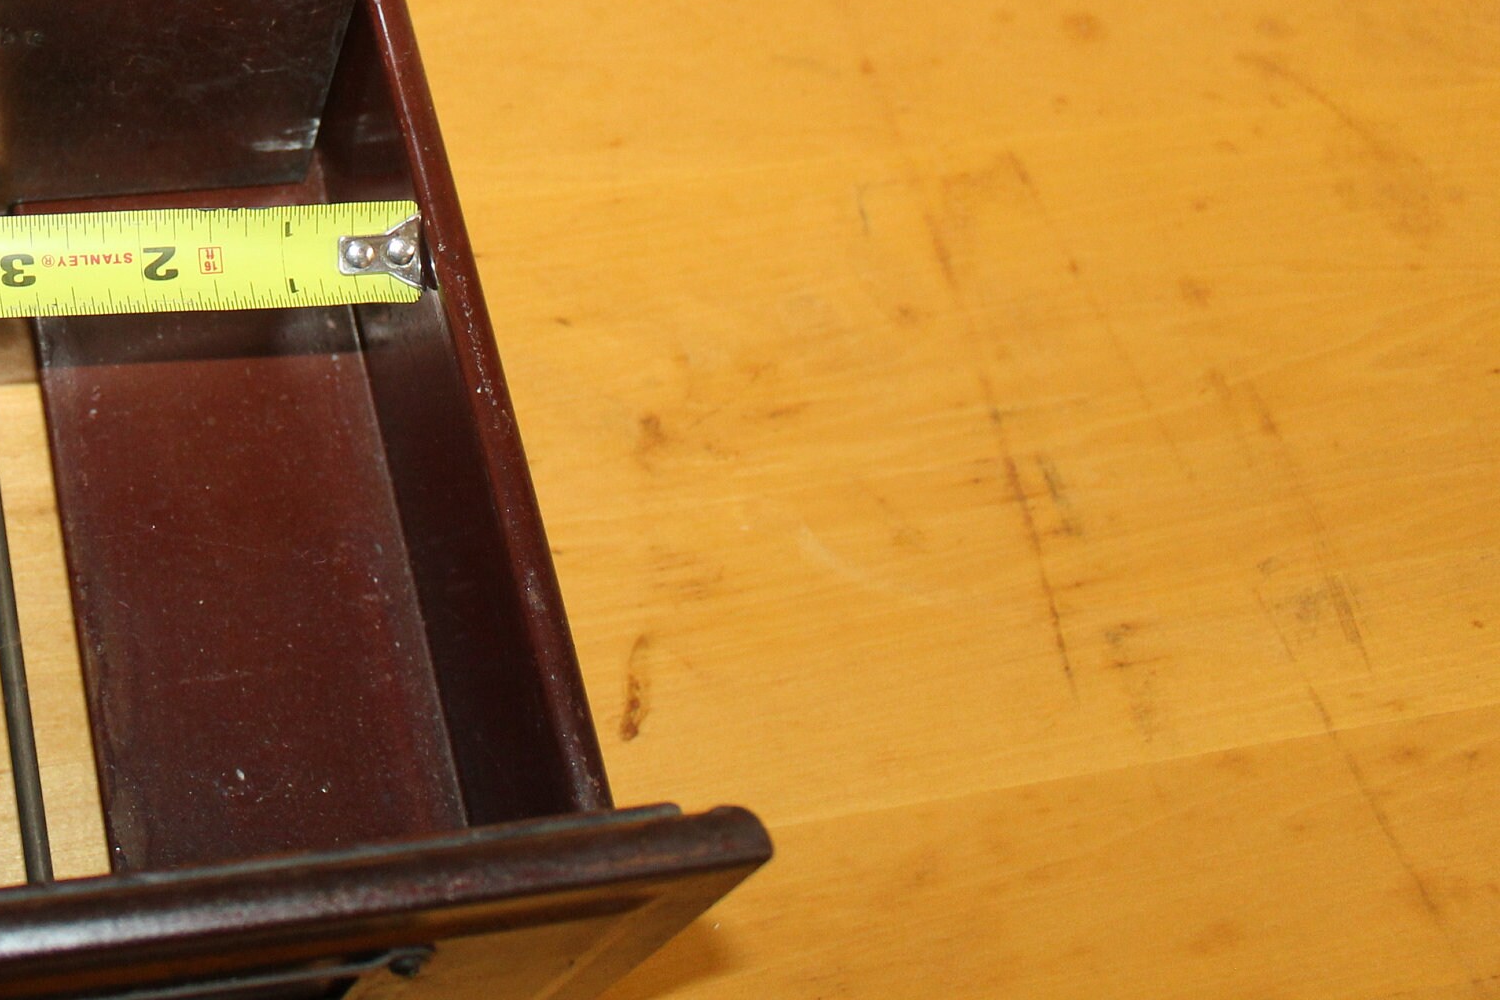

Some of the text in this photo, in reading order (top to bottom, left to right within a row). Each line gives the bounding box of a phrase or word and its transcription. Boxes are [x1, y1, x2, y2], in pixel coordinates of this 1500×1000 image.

[285, 222, 293, 237] 1
[205, 247, 215, 259] ft
[0, 253, 37, 288] 3
[143, 246, 179, 281] 2
[204, 260, 218, 271] 16
[288, 278, 299, 293] 1
